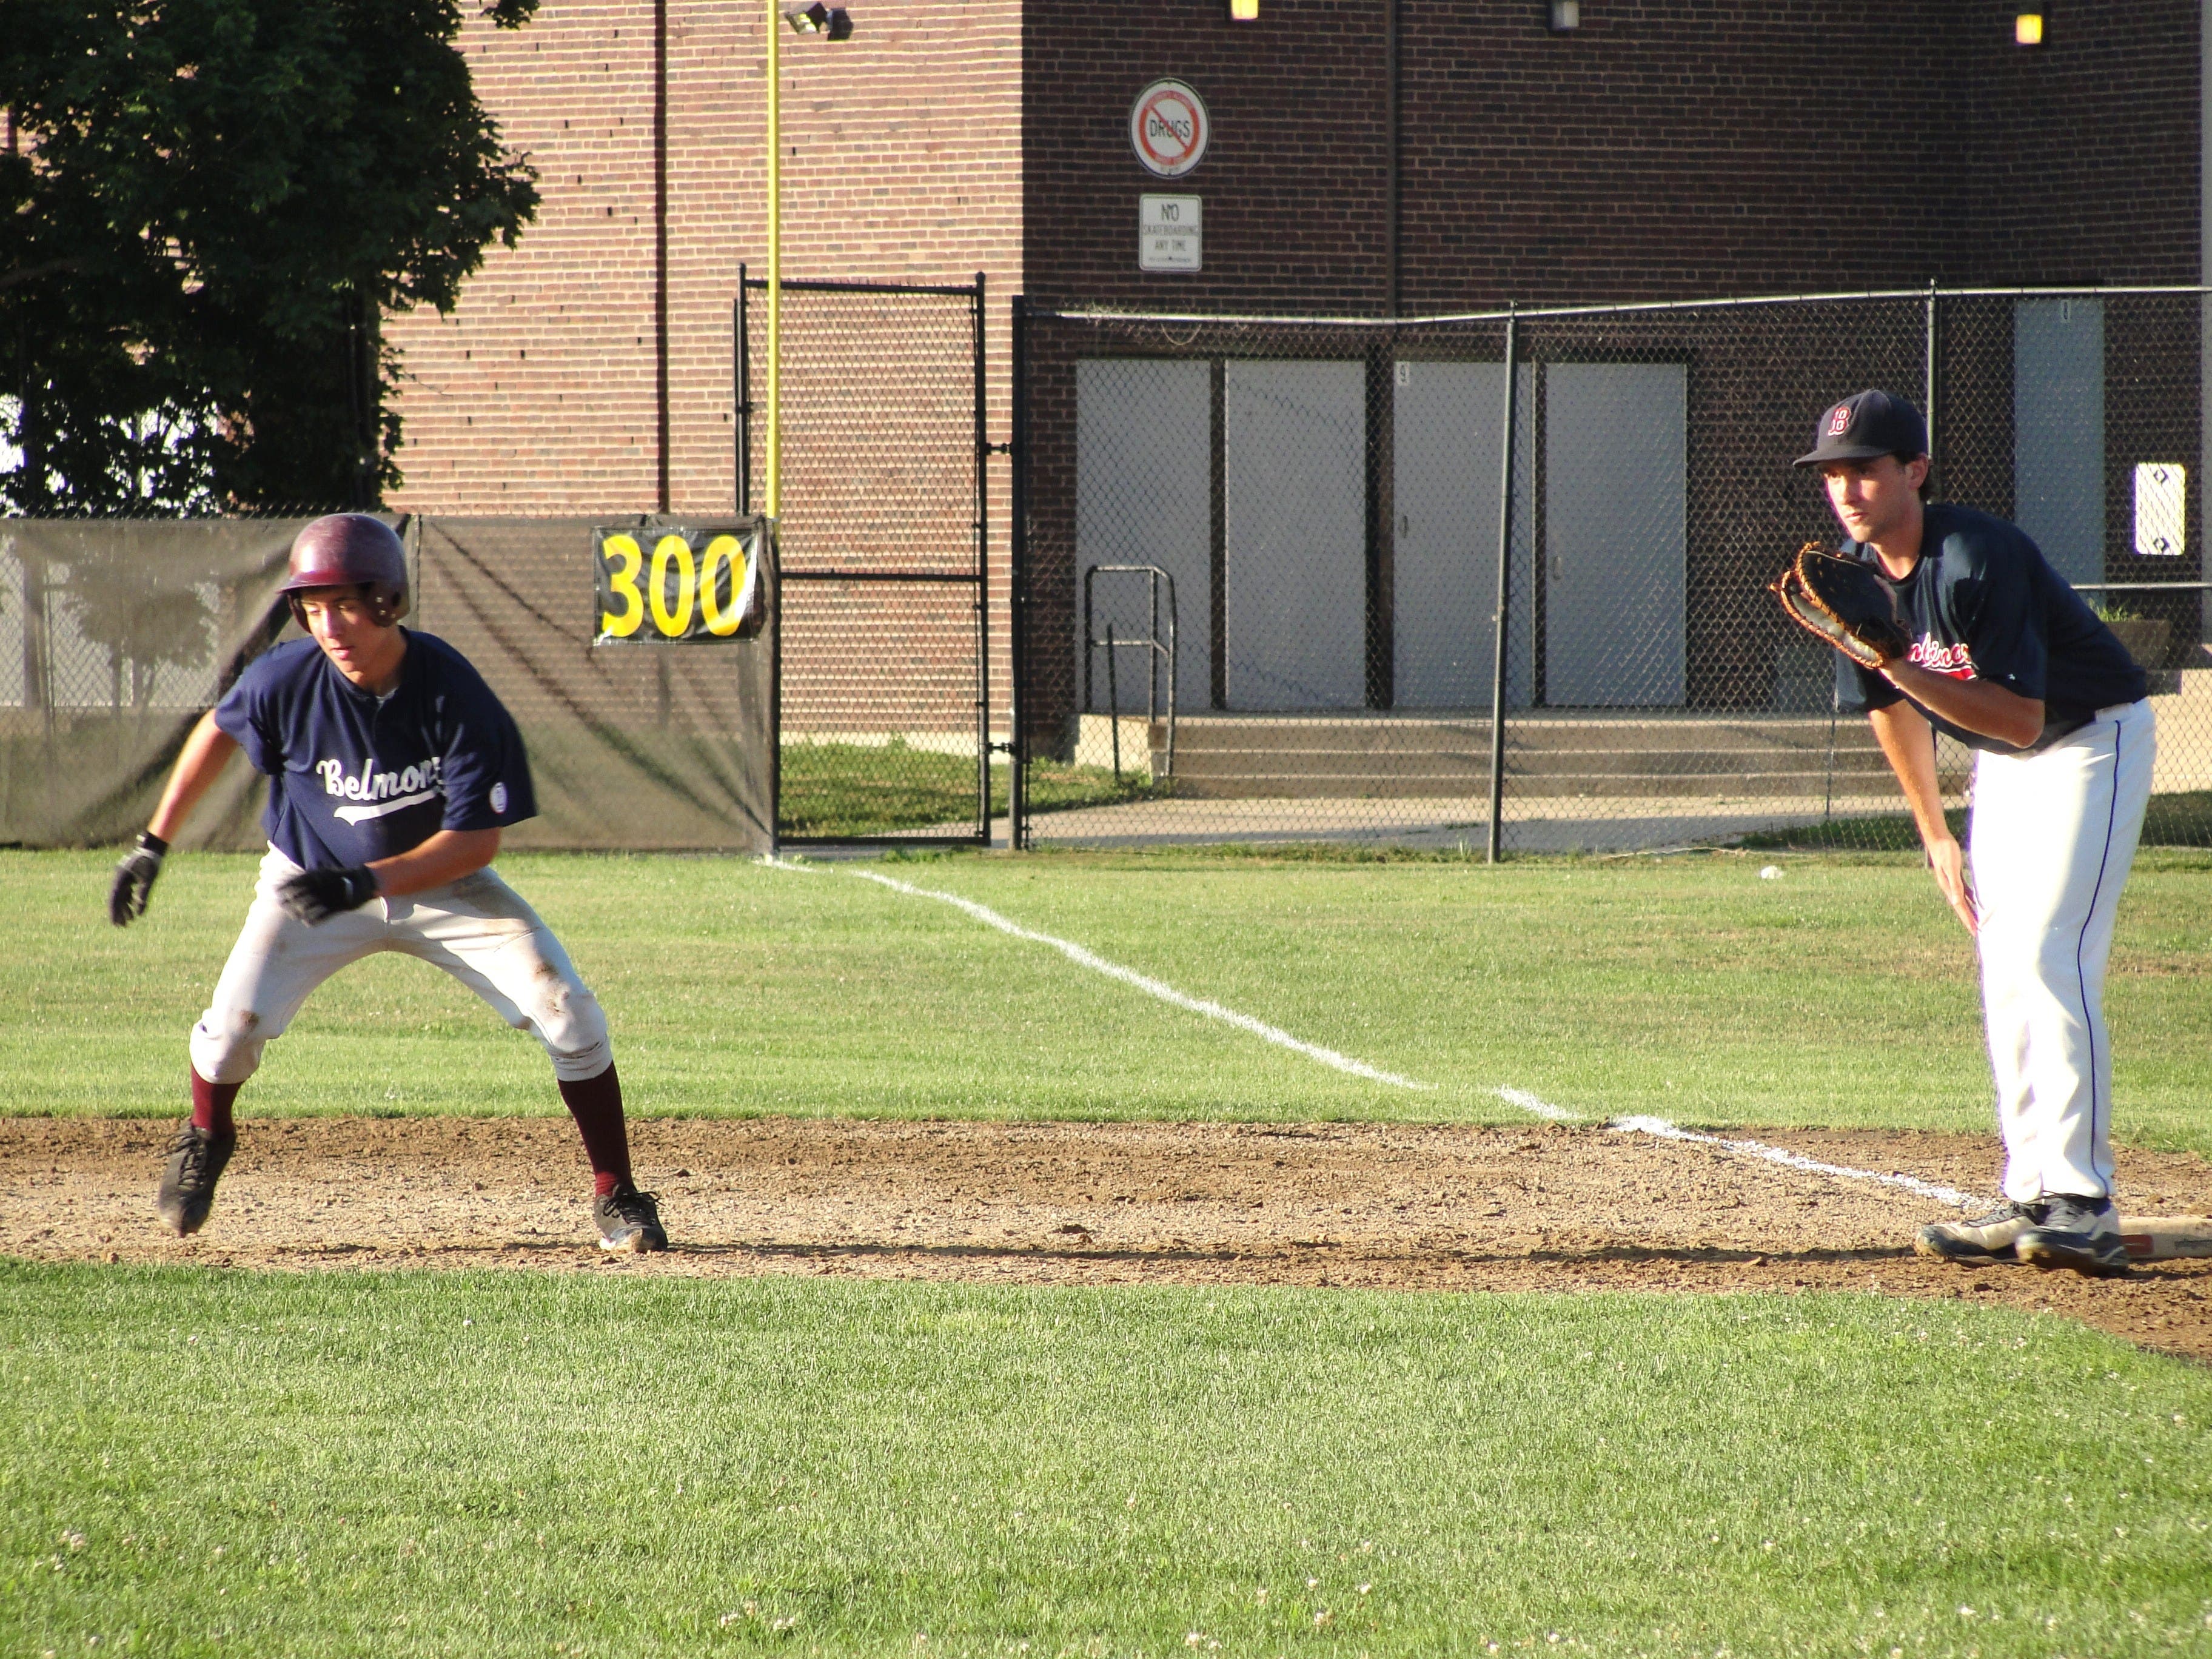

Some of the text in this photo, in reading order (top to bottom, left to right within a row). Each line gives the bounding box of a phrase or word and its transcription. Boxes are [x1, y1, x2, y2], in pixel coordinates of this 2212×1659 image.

[1150, 119, 1190, 138] DRUGS
[1161, 204, 1179, 221] NO
[1828, 405, 1851, 437] B
[602, 534, 747, 637] 300
